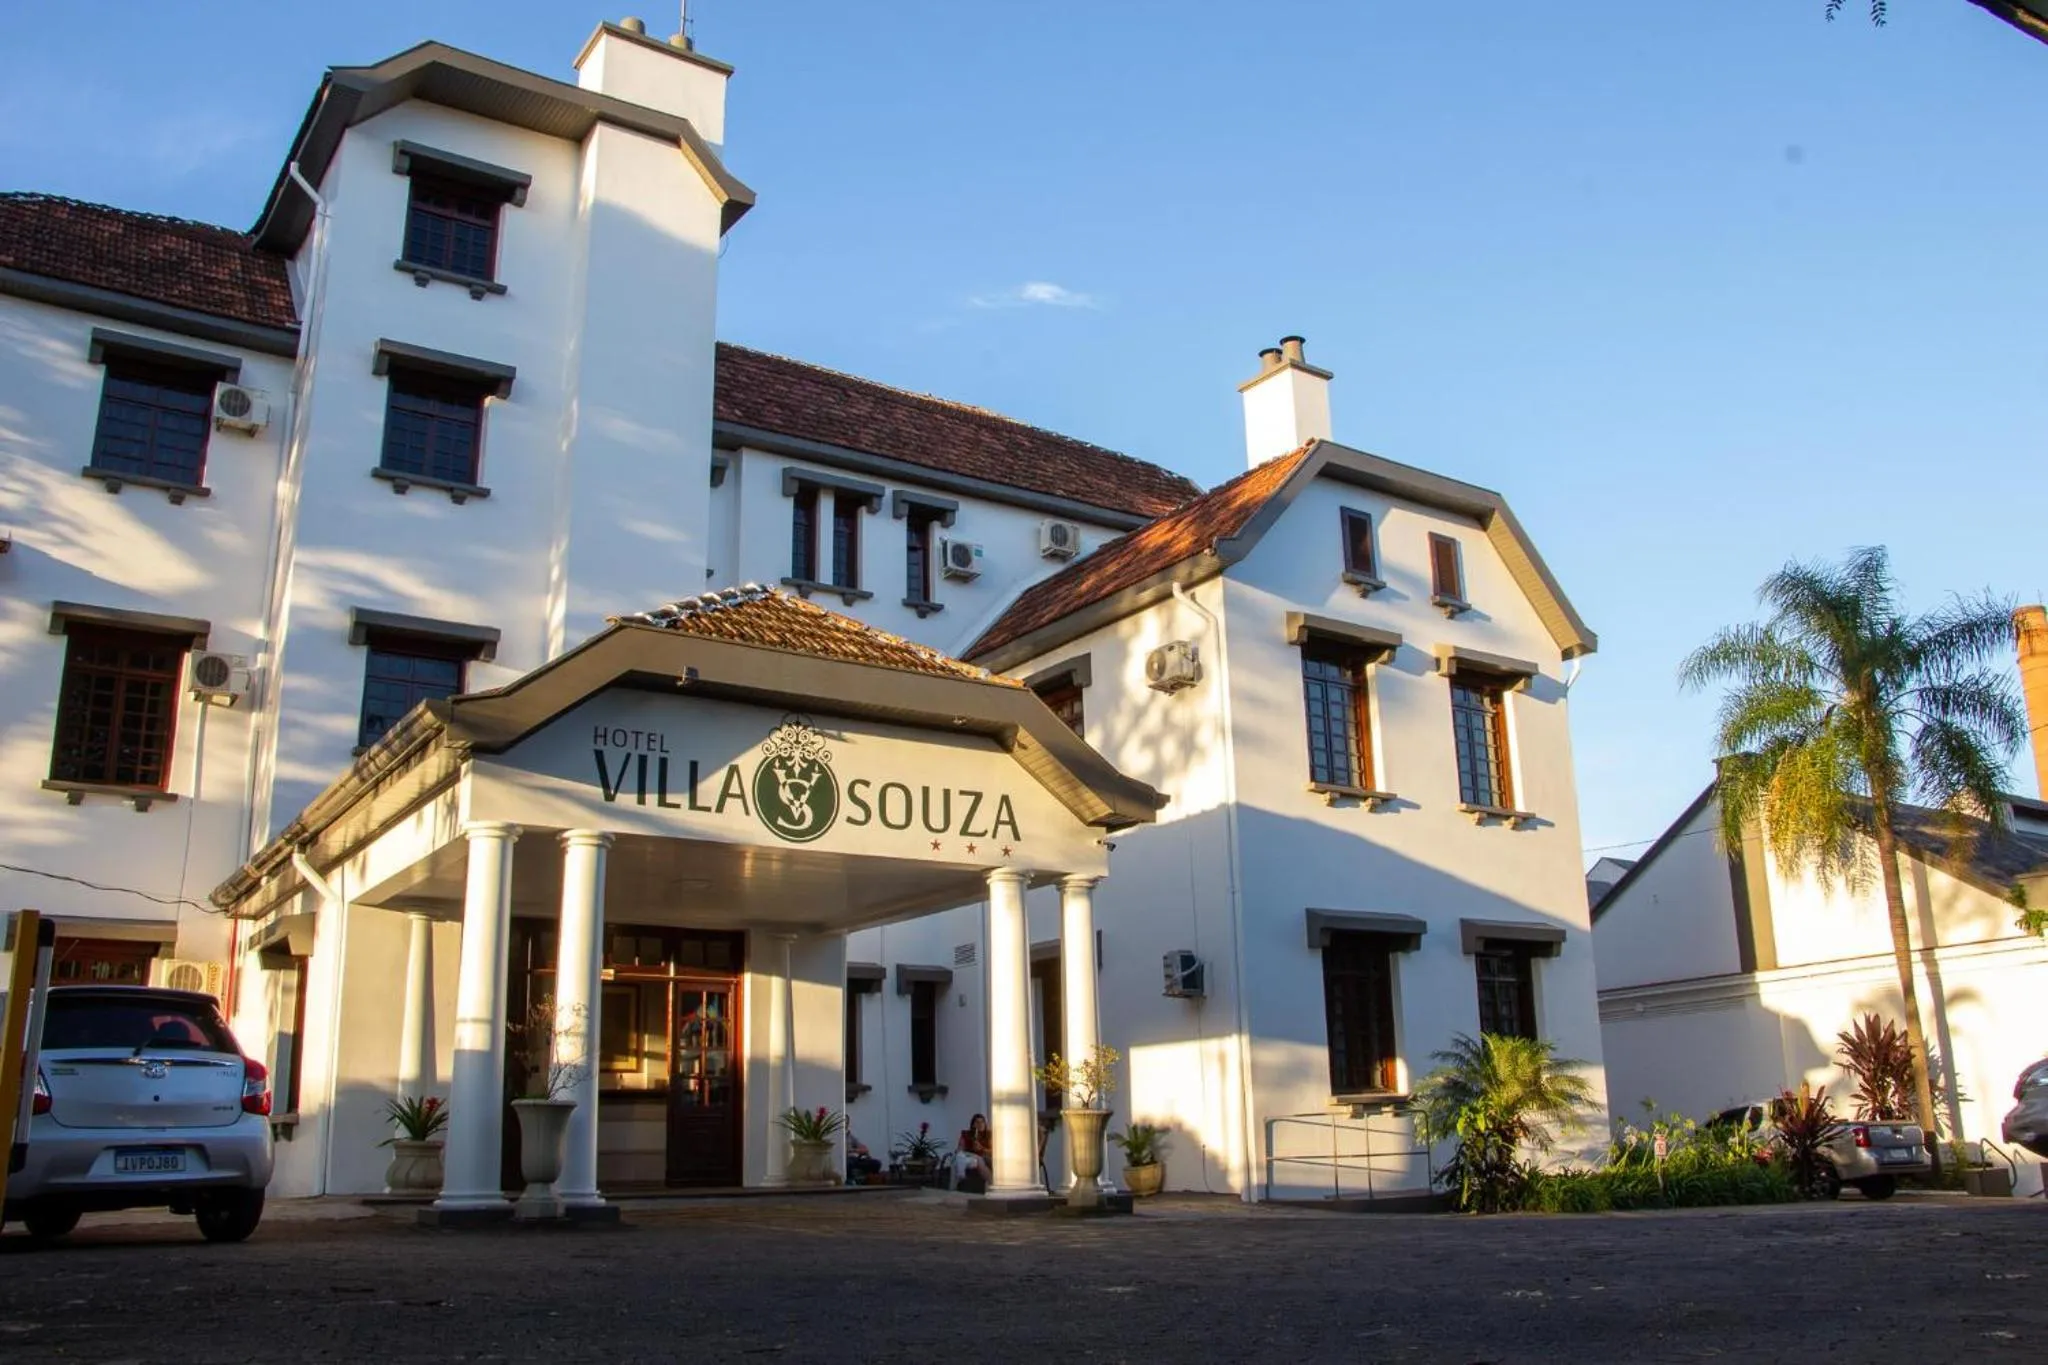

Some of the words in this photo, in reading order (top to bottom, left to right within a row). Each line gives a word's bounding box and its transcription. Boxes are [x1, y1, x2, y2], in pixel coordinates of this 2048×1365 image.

[594, 726, 669, 753] HOTEL
[594, 749, 750, 816] VILLA
[845, 779, 1021, 842] SOUZA
